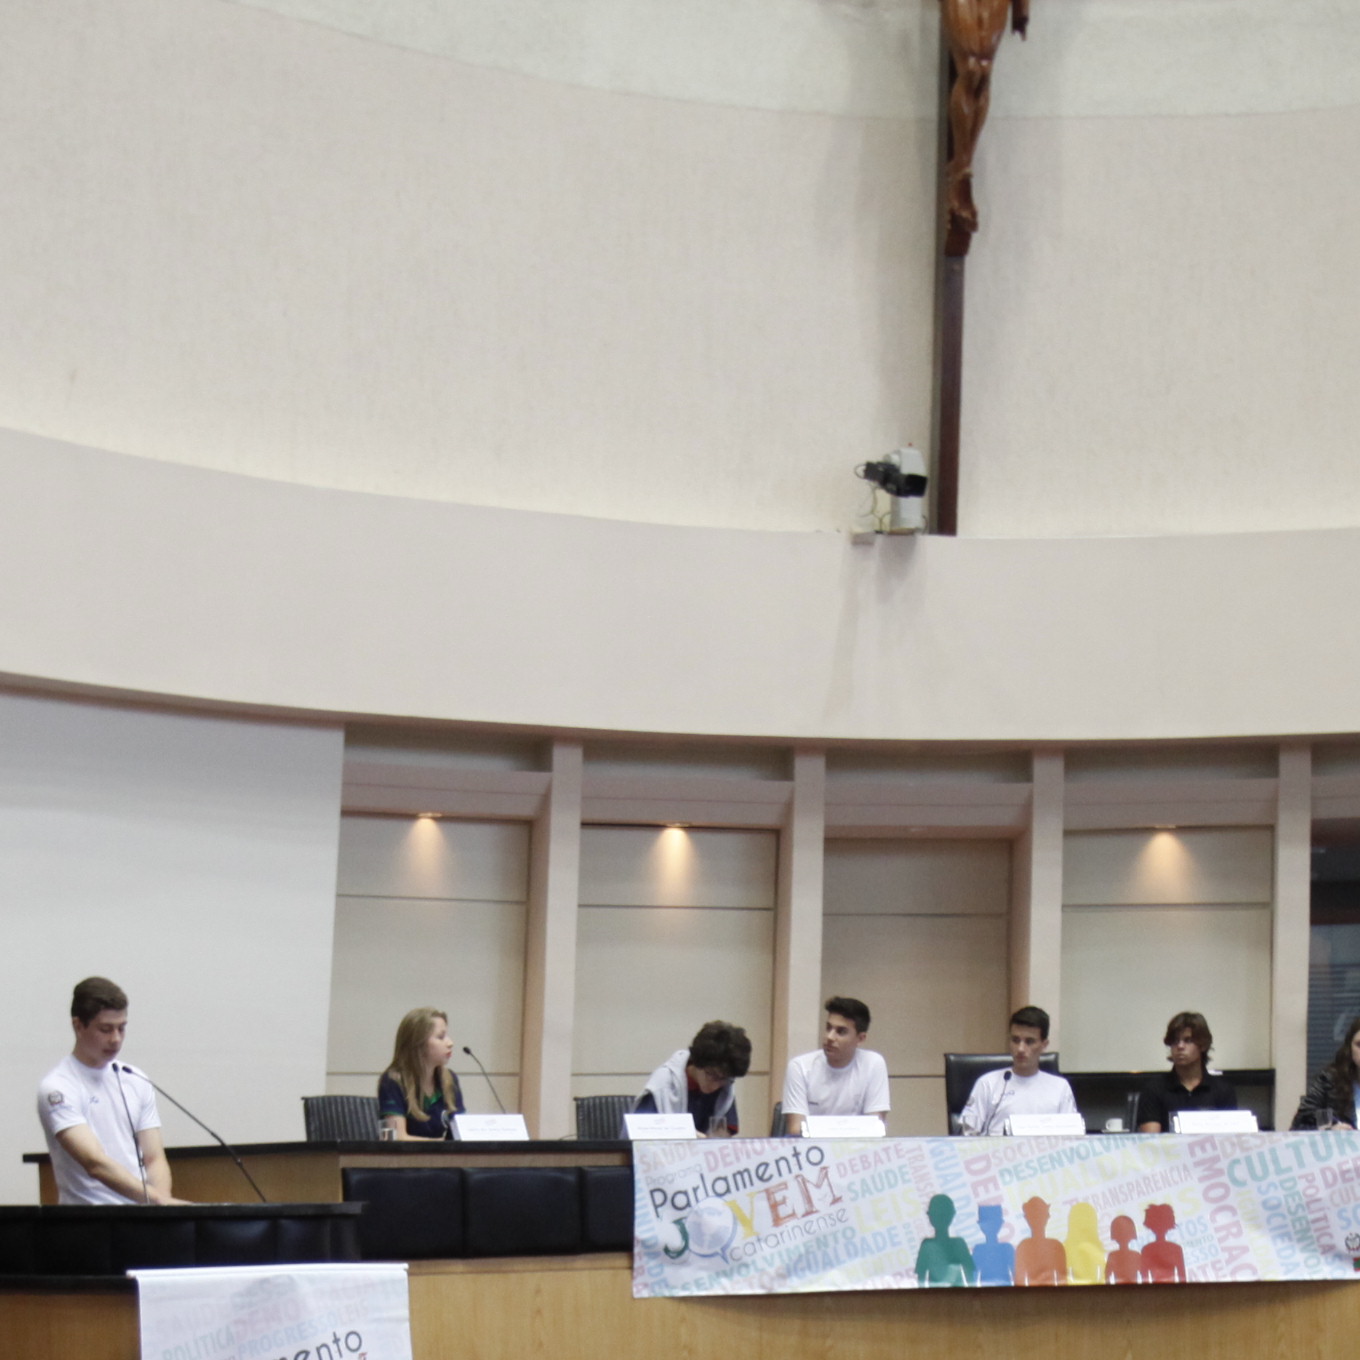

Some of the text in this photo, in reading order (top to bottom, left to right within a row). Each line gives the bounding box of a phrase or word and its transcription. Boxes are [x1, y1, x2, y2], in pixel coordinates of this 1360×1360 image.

[649, 1145, 825, 1218] Parlamento
[835, 1142, 906, 1180] DEBATE
[662, 1166, 844, 1266] JOVEM
[729, 1207, 849, 1262] catarinense
[853, 1187, 923, 1234] LEIS
[1187, 1136, 1259, 1280] EMOCRAC
[1256, 1181, 1301, 1276] SOCIEDA
[785, 1226, 902, 1281] IGUALDADE
